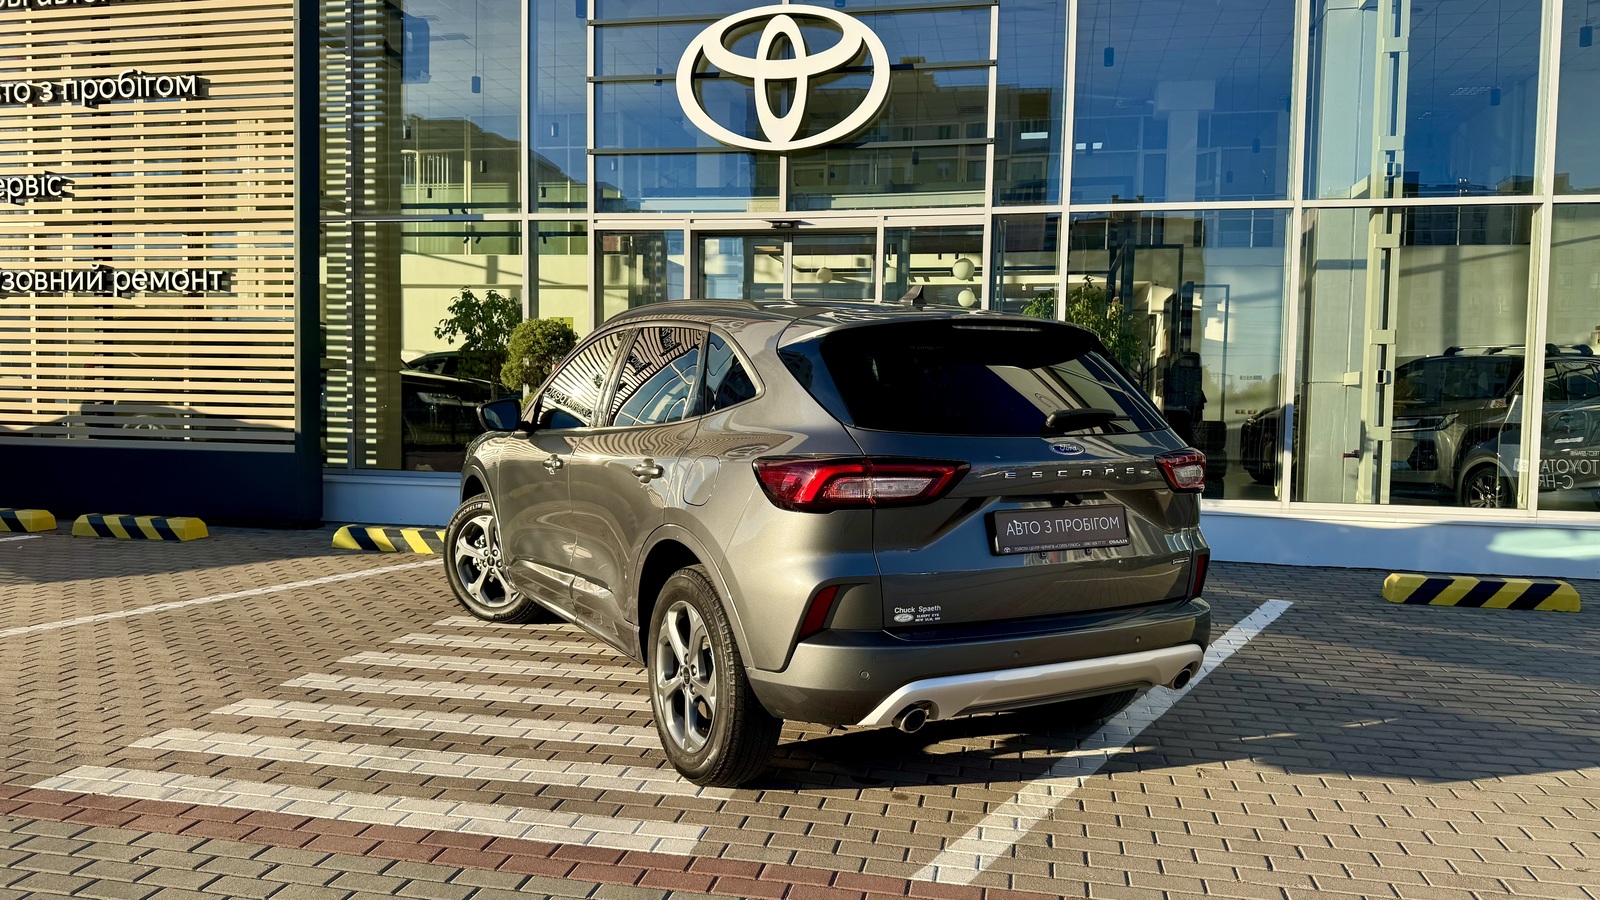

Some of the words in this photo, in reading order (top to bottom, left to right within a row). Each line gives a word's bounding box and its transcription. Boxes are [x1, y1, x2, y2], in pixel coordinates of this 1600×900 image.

[0, 83, 31, 102] то
[39, 81, 53, 102] з
[63, 69, 197, 106] пробігом
[0, 263, 103, 291] зовний
[113, 269, 223, 297] ремонт
[1004, 467, 1135, 479] ESCAPE
[1006, 520, 1041, 536] АВТО
[1044, 520, 1053, 534] З
[1055, 516, 1120, 533] ПРОБІГОМ
[918, 605, 942, 613] Spaeth
